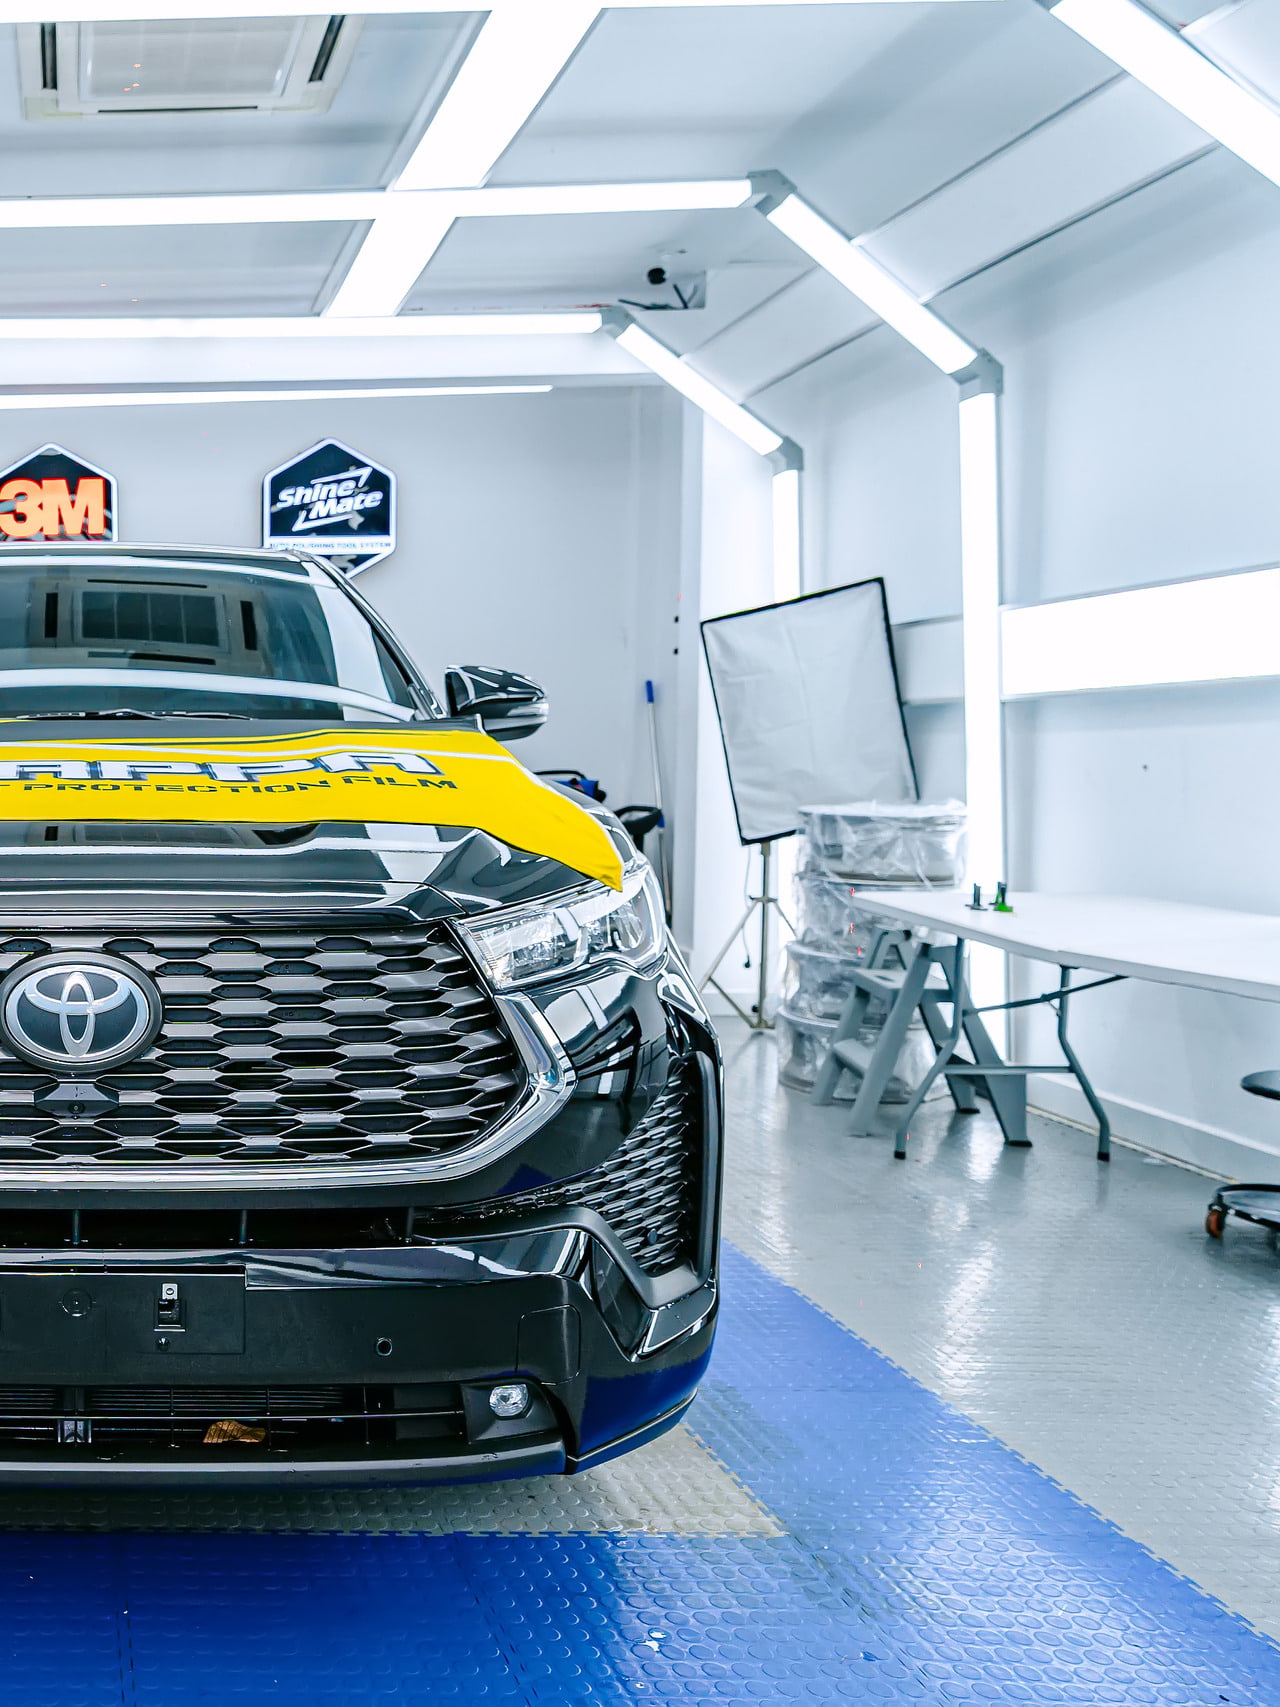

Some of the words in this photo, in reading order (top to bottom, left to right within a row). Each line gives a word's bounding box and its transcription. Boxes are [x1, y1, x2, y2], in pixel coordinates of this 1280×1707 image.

[276, 479, 357, 508] Shine
[308, 490, 384, 520] Mate
[23, 780, 331, 794] PROTECTION
[342, 775, 458, 790] FILM
